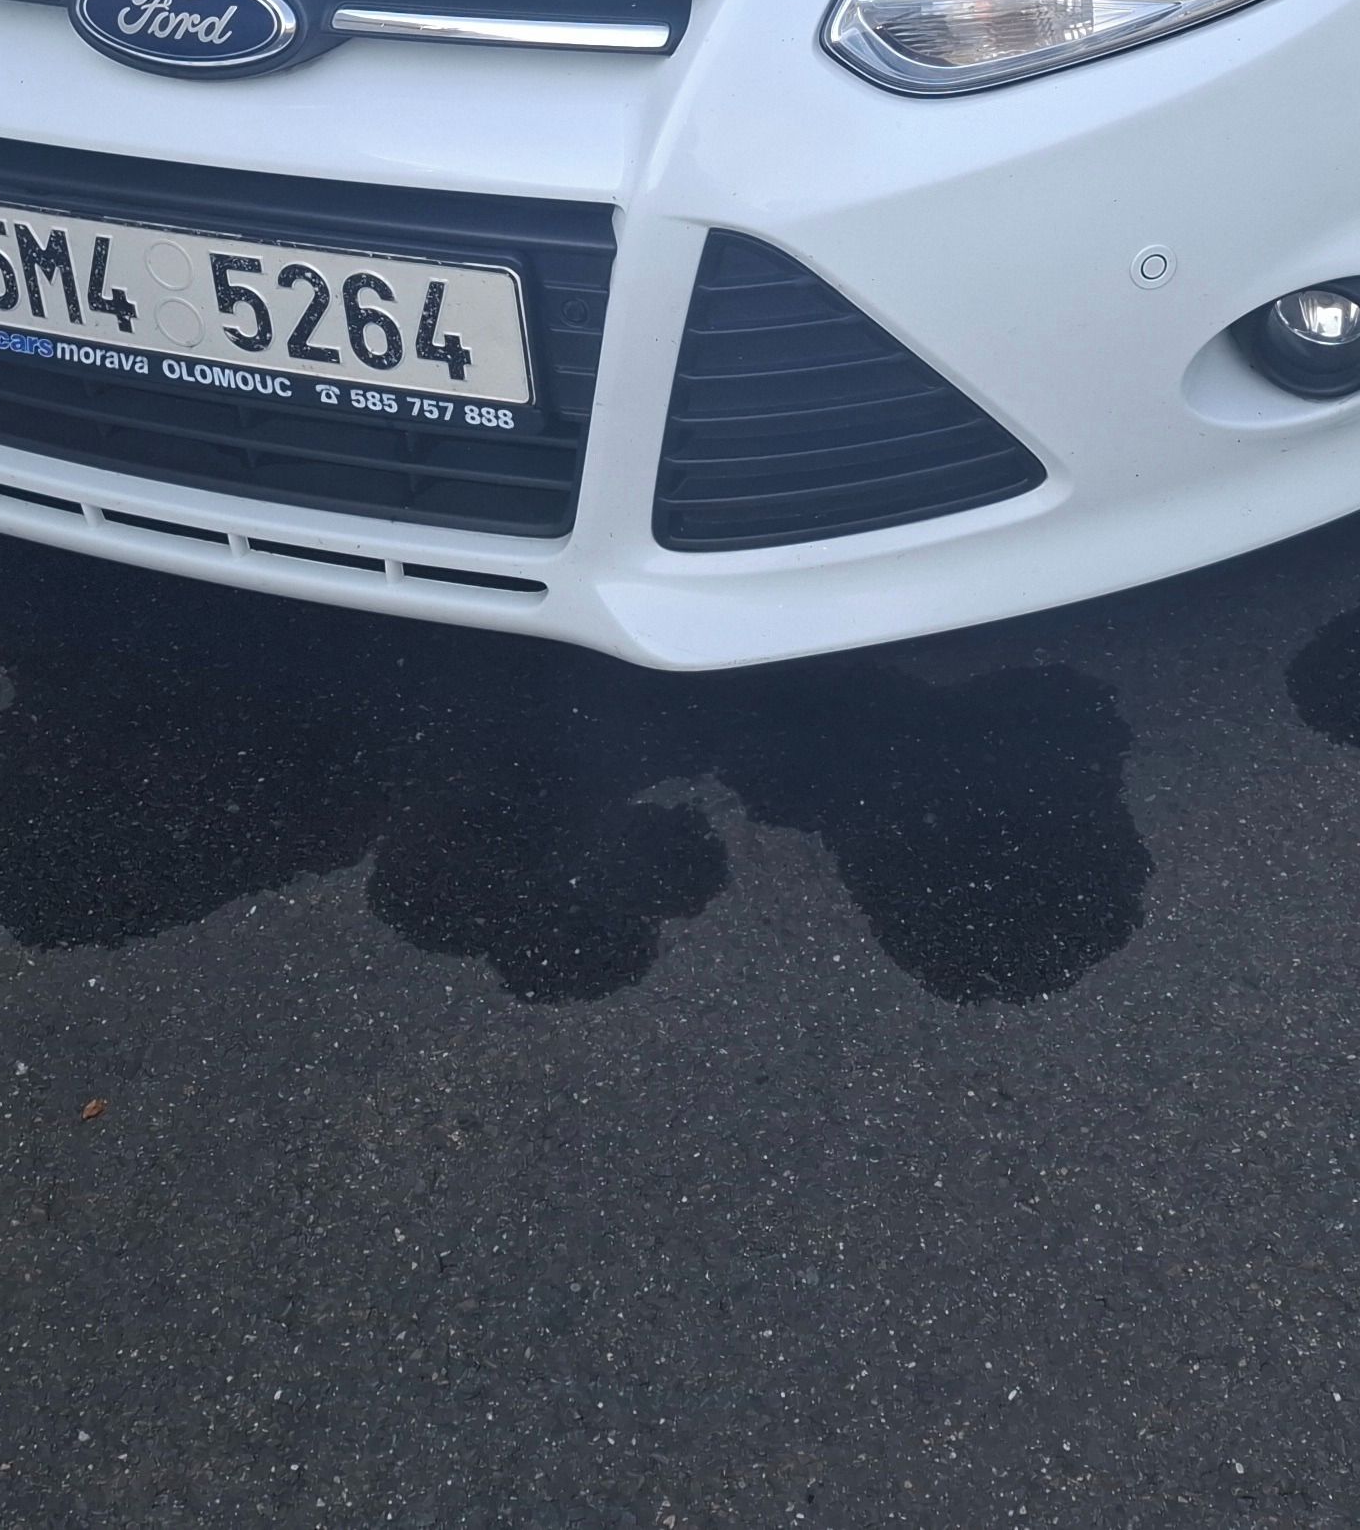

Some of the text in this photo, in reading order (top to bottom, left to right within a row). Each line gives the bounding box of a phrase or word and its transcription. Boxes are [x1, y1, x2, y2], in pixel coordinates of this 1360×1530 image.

[209, 252, 473, 381] 5264
[162, 359, 293, 397] OLOMOUC
[350, 389, 399, 413] 585
[406, 397, 454, 421] 757
[464, 405, 515, 429] 888
